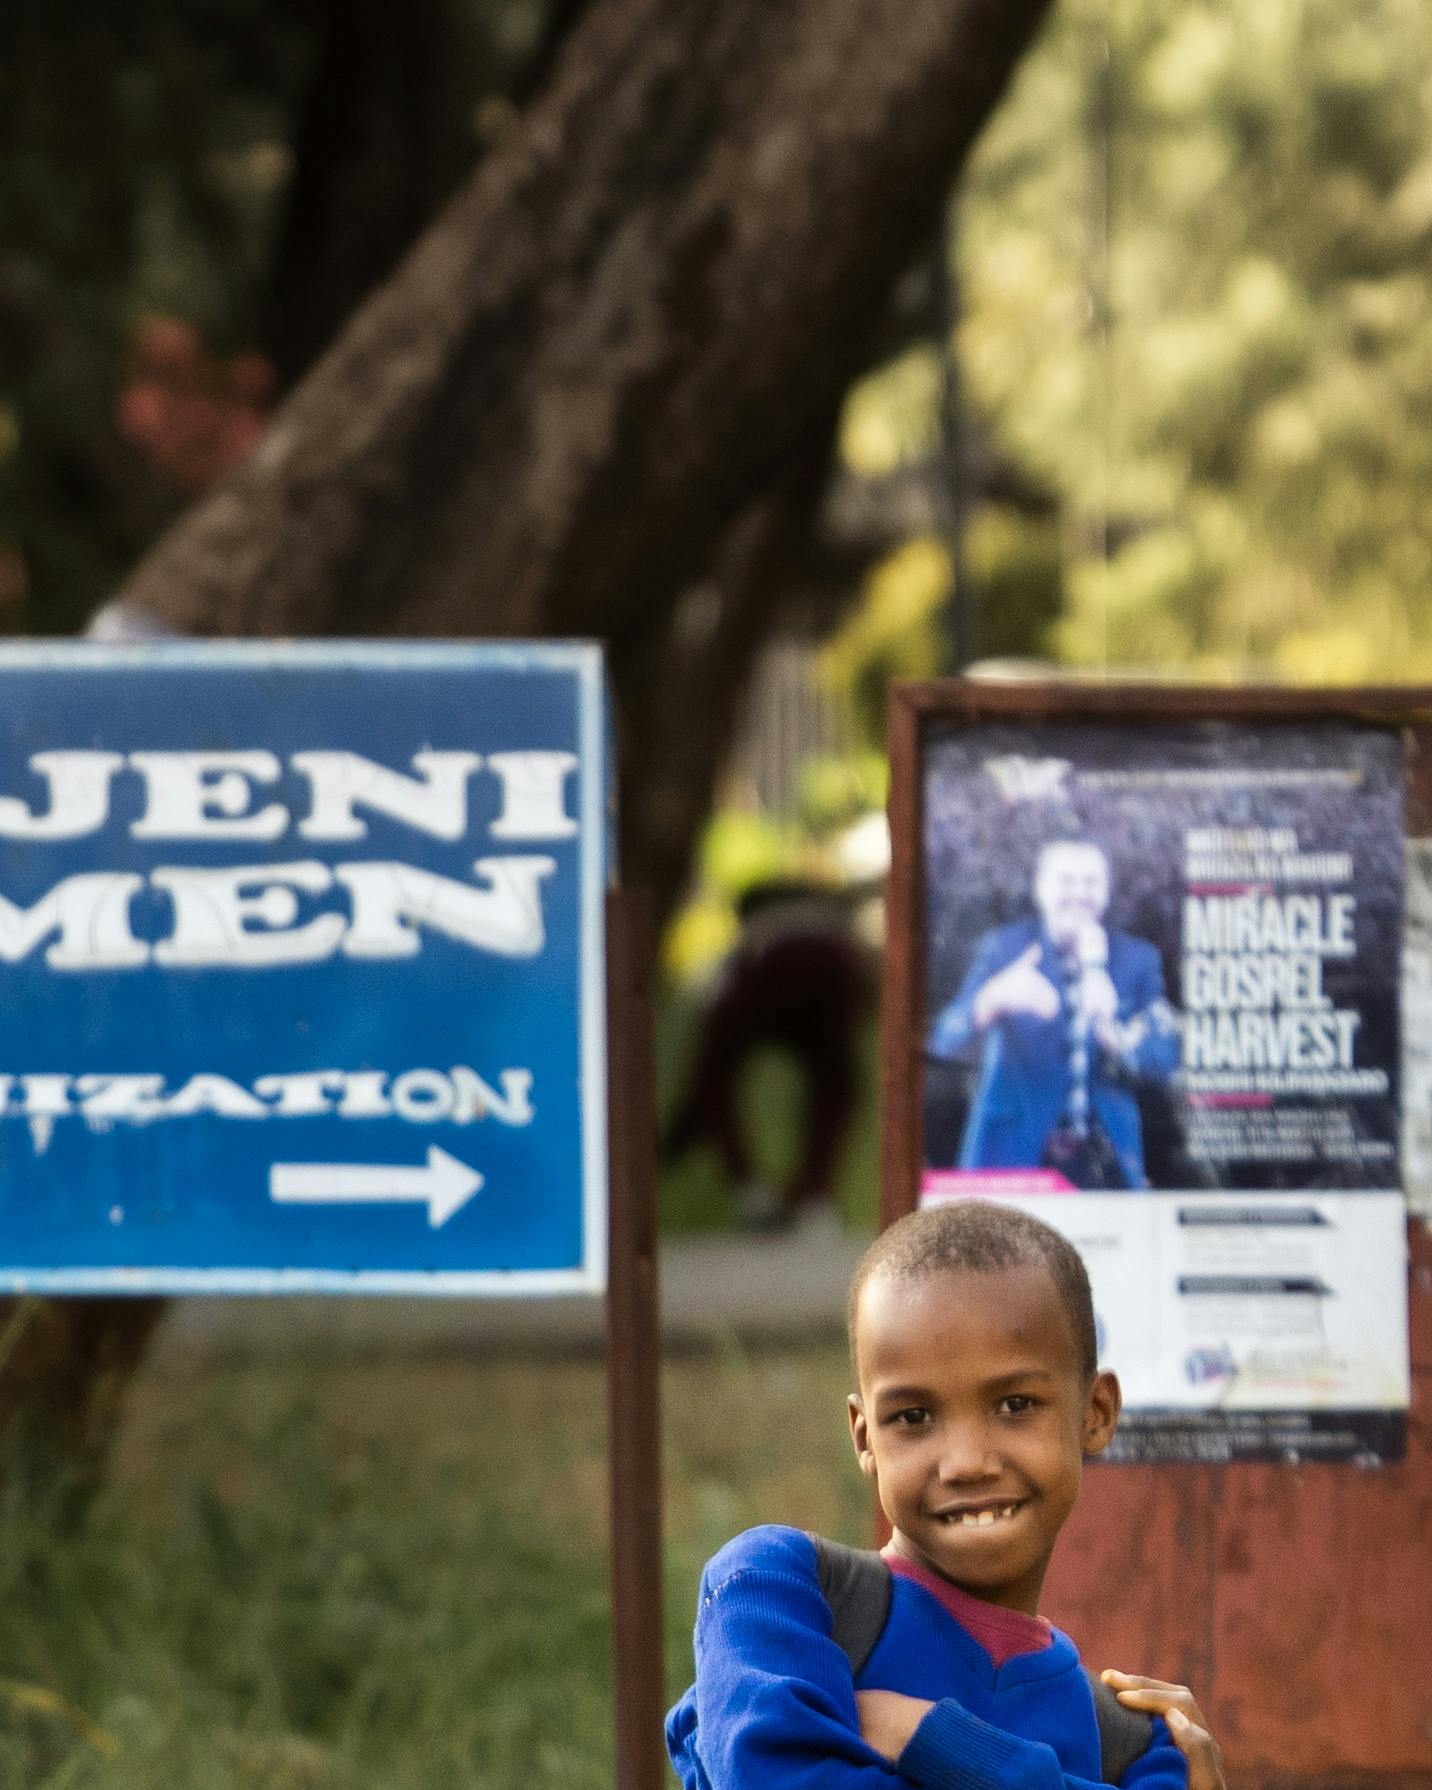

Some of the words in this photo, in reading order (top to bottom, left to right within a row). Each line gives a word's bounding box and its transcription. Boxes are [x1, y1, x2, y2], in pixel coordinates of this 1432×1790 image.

[0, 750, 578, 840] JENI
[1184, 894, 1357, 957] MIRACLE
[1184, 952, 1334, 1010] GOSPEL
[1182, 1010, 1360, 1069] HARVEST
[0, 1064, 533, 1126] IZATION
